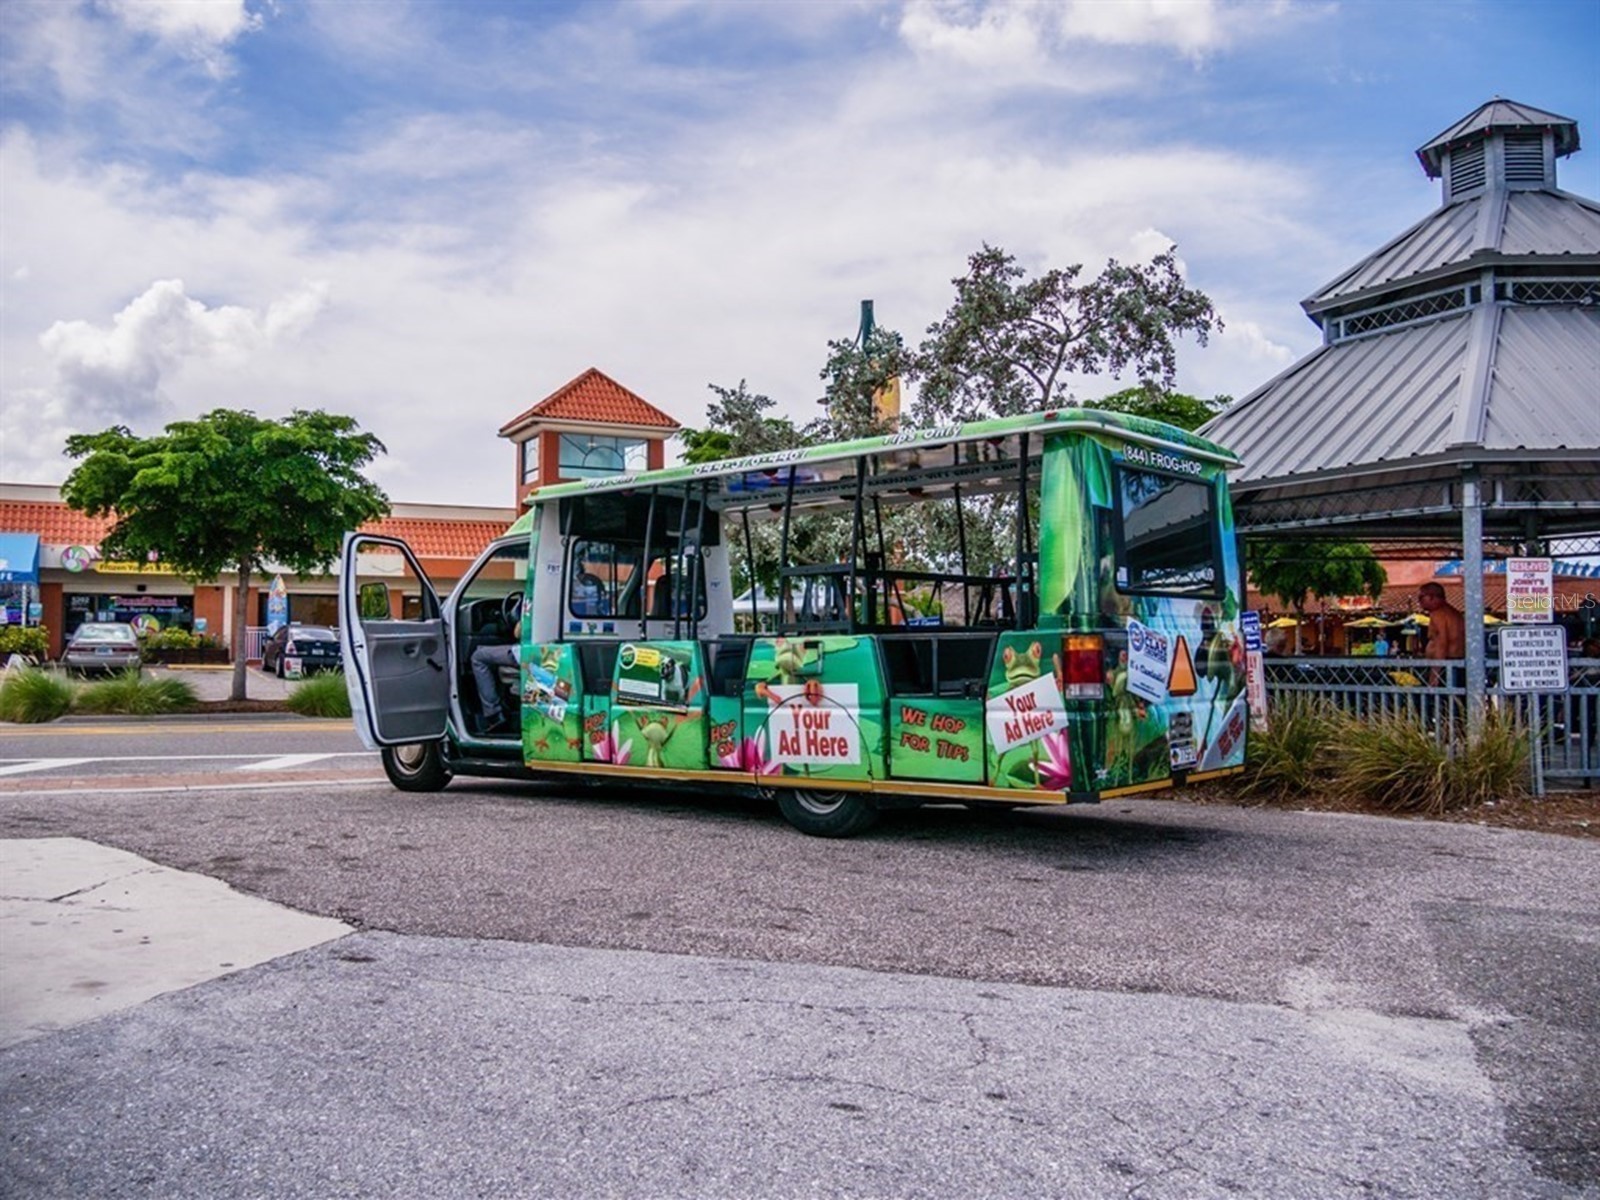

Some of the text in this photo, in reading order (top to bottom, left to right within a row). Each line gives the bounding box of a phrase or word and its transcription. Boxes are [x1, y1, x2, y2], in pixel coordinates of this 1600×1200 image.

[1122, 443, 1202, 475] (844) FROG-HOP
[1004, 690, 1037, 714] Your
[584, 711, 607, 733] HOP
[790, 703, 831, 729] Your
[901, 706, 966, 735] WE HOP
[1003, 709, 1054, 744] Ad Here
[589, 731, 606, 745] ON
[710, 720, 737, 743] HOP
[778, 730, 849, 757] Ad Here
[716, 741, 735, 757] ON
[900, 733, 969, 762] FOR TIPS
